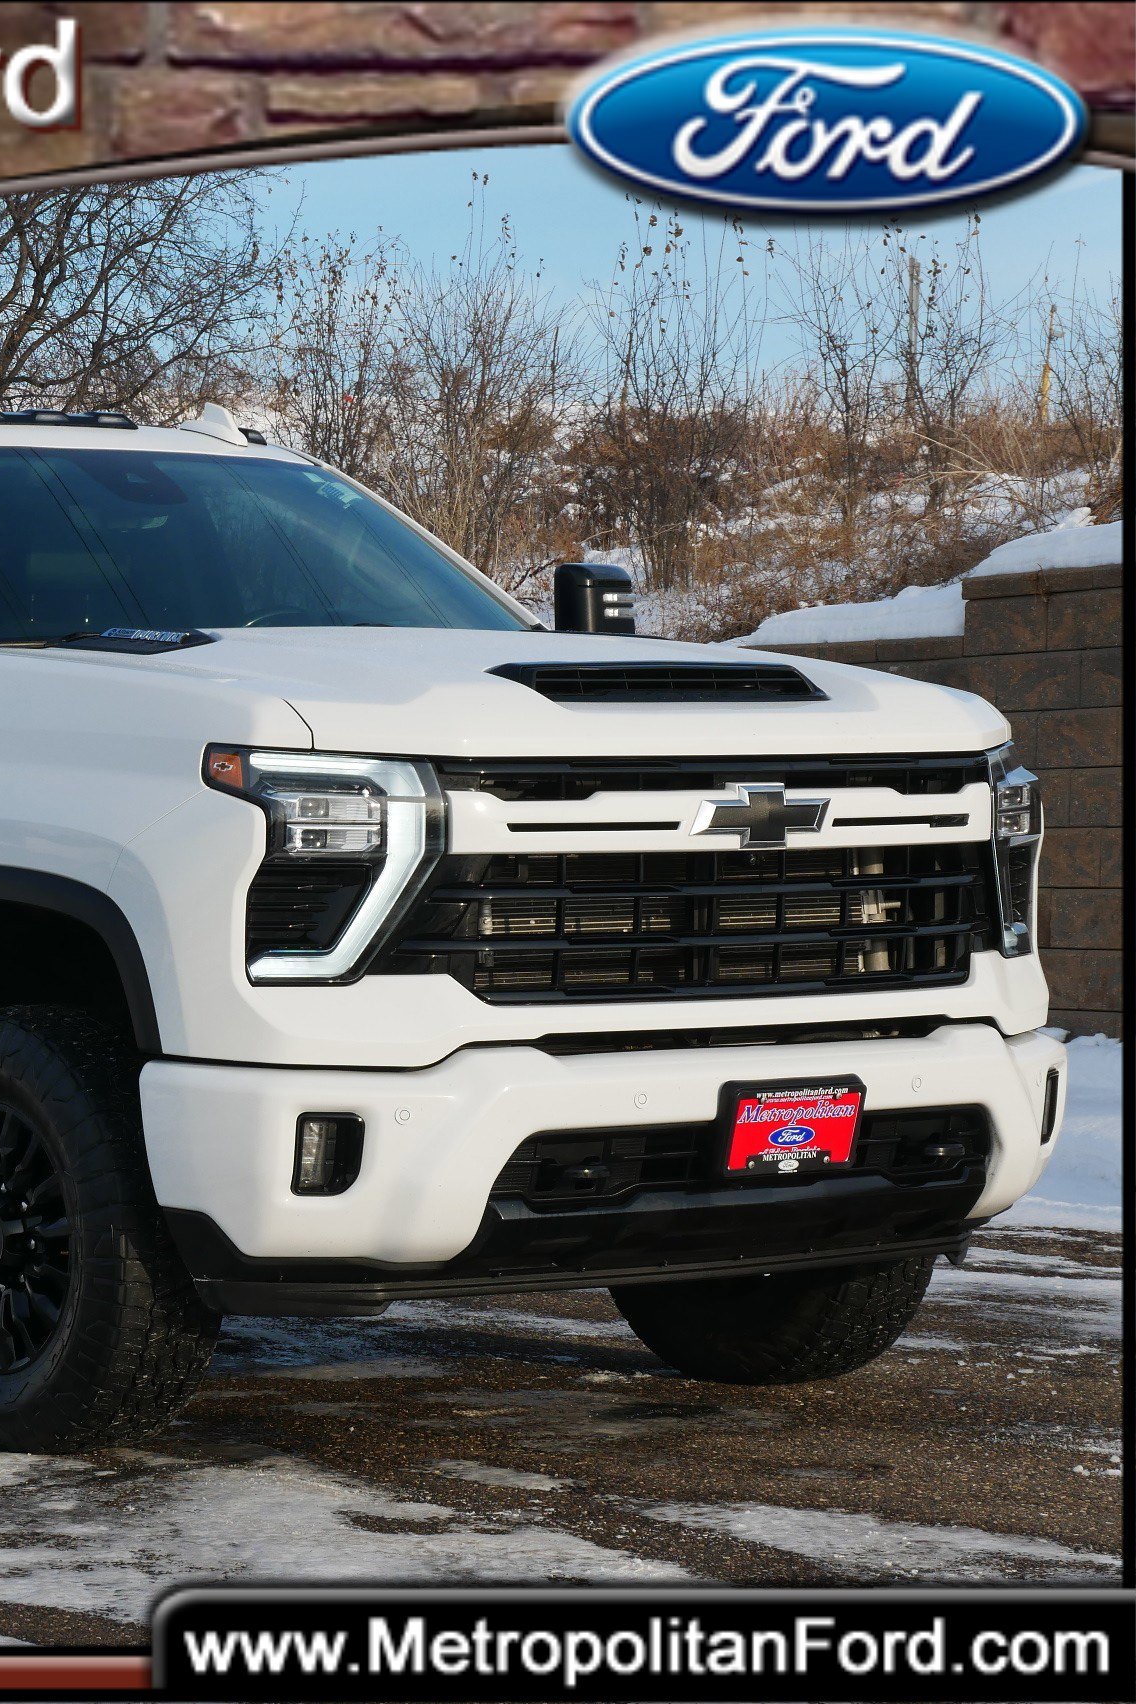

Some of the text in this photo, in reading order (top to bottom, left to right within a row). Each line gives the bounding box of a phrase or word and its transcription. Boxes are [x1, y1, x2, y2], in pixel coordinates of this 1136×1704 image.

[757, 1087, 848, 1098] www.metropolitanford.com
[737, 1100, 855, 1126] Metropolitan
[778, 1129, 804, 1142] Ford
[762, 1151, 817, 1161] METROPOLITAN
